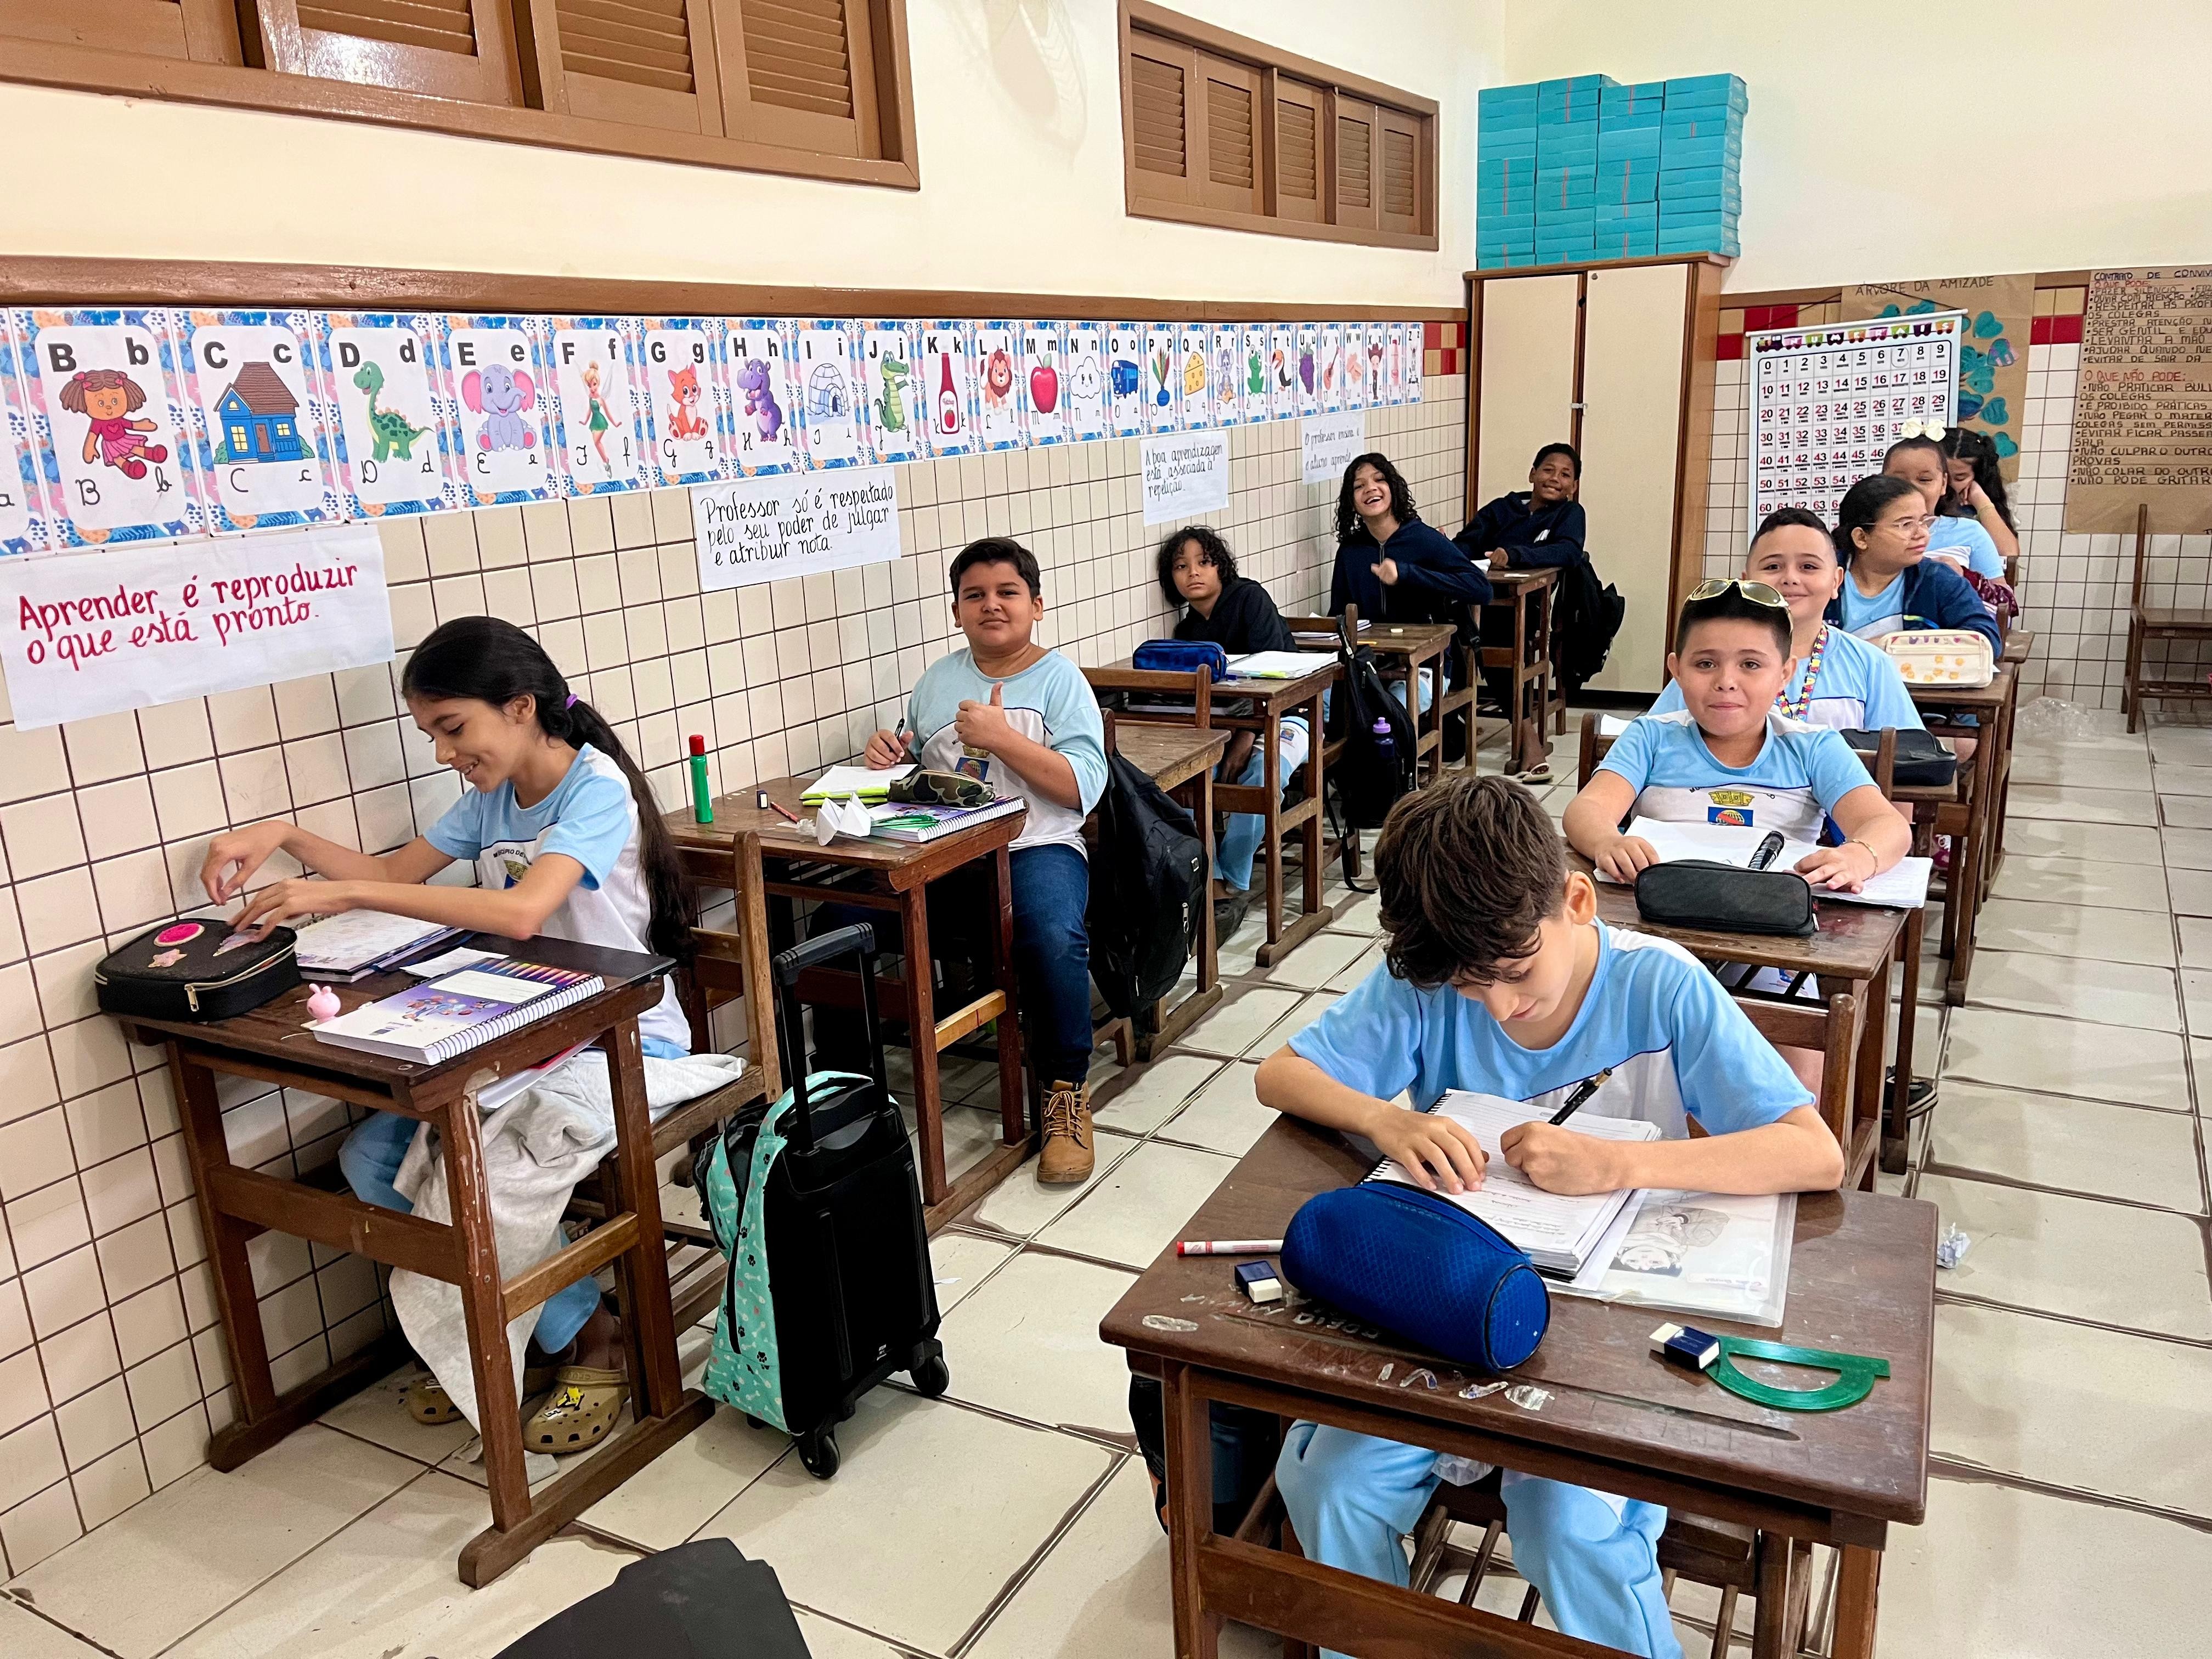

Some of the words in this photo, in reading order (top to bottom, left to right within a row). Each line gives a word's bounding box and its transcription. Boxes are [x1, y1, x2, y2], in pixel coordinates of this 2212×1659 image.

[1914, 280, 1929, 292] DA
[1940, 275, 1994, 289] AMIZADE
[2096, 301, 2154, 311] RESPEITAR
[2108, 310, 2159, 319] COLEGAS
[2092, 319, 2135, 327] PRESTAR
[2092, 328, 2113, 336] SER
[2119, 326, 2165, 335] GENTIL
[733, 337, 747, 358] H
[768, 338, 778, 357] h
[838, 338, 843, 356] i
[928, 336, 938, 354] K
[953, 336, 962, 353] k
[979, 339, 987, 356] L
[1026, 338, 1036, 354] M
[1047, 340, 1057, 351] m
[1071, 338, 1079, 353] N
[1091, 339, 1097, 351] n
[1111, 338, 1119, 353] O
[1130, 340, 1136, 350] o
[1149, 338, 1154, 352] P
[1167, 338, 1172, 352] p
[1183, 338, 1189, 352] Q
[1199, 340, 1204, 353] q
[1216, 335, 1221, 348] R
[1246, 335, 1251, 347] S
[1260, 337, 1264, 346] s
[2091, 335, 2152, 345] LEVANTAR
[2165, 335, 2172, 344] A
[48, 343, 77, 372] B
[126, 337, 149, 365] b
[204, 341, 228, 369] C
[273, 343, 292, 363] c
[338, 342, 360, 368] D
[399, 338, 416, 363] d
[458, 342, 476, 366] E
[510, 344, 525, 362] e
[562, 342, 574, 364] F
[608, 338, 616, 360] f
[651, 341, 666, 363] G
[692, 342, 704, 364] g
[869, 341, 878, 358] J
[899, 338, 904, 360] j
[1802, 358, 1808, 366] 2
[1821, 356, 1827, 364] 3
[1839, 354, 1846, 362] 4
[1859, 352, 1865, 360] 5
[1878, 350, 1884, 359] 6
[1898, 348, 1904, 357] 7
[1917, 346, 1923, 355] 8
[1937, 345, 1944, 353] 9
[2089, 346, 2130, 354] AJUDAR
[2140, 345, 2186, 354] QUANDO
[2087, 355, 2122, 363] EVITAR
[1762, 386, 1773, 394] 10
[1780, 384, 1790, 392] 11
[1798, 382, 1809, 391] 12
[1817, 381, 1828, 389] 13
[1836, 379, 1848, 387] 14
[1855, 377, 1867, 386] 15
[1874, 375, 1886, 384] 16
[1894, 374, 1906, 382] 17
[1914, 371, 1926, 381] 18
[1933, 370, 1946, 379] 19
[2085, 370, 2092, 380] O
[2097, 370, 2119, 382] QUE
[2124, 368, 2144, 381] NÃO
[2118, 382, 2174, 391] PRATICAR
[2080, 392, 2095, 401] OS
[2100, 392, 2151, 400] COLEGAS
[1761, 409, 1773, 418] 20
[1779, 408, 1790, 417] 21
[1797, 407, 1809, 415] 22
[1815, 405, 1827, 414] 23
[1835, 403, 1847, 412] 24
[1854, 402, 1866, 410] 25
[1873, 400, 1886, 409] 26
[1893, 398, 1905, 407] 27
[1912, 397, 1925, 406] 28
[1932, 394, 1945, 404] 29
[2097, 402, 2147, 410] PROIBIDO
[2113, 411, 2147, 420] PEGAR
[2081, 429, 2121, 437] EVITAR
[2126, 429, 2163, 437] FICAR
[2074, 438, 2104, 447] SALA
[1146, 450, 1151, 466] A
[1152, 448, 1167, 465] boa
[1171, 442, 1223, 467] aprendizagem
[2073, 456, 2120, 465] PROVAS
[1147, 464, 1161, 482] está
[2104, 467, 2145, 476] COLAR
[2155, 467, 2170, 476] DO
[2114, 476, 2147, 484] PODE
[2158, 475, 2211, 484] GRITAR
[1148, 477, 1186, 501] repetição.
[701, 492, 780, 524] Professor
[793, 489, 809, 514] só
[815, 488, 823, 509] é
[830, 479, 893, 511] respeitado
[708, 527, 735, 554] pelo
[744, 524, 770, 540] seu
[778, 515, 814, 545] poder
[823, 510, 838, 531] de
[847, 506, 889, 534] julgar
[714, 551, 723, 566] e
[730, 540, 790, 565] atribuir
[798, 534, 833, 555] nota.
[19, 584, 158, 642] Aprender
[183, 574, 199, 608] é
[211, 557, 358, 609] reproduzir
[27, 639, 45, 665] o
[57, 628, 117, 671] que
[129, 611, 199, 648] está
[211, 600, 320, 647] pronto.
